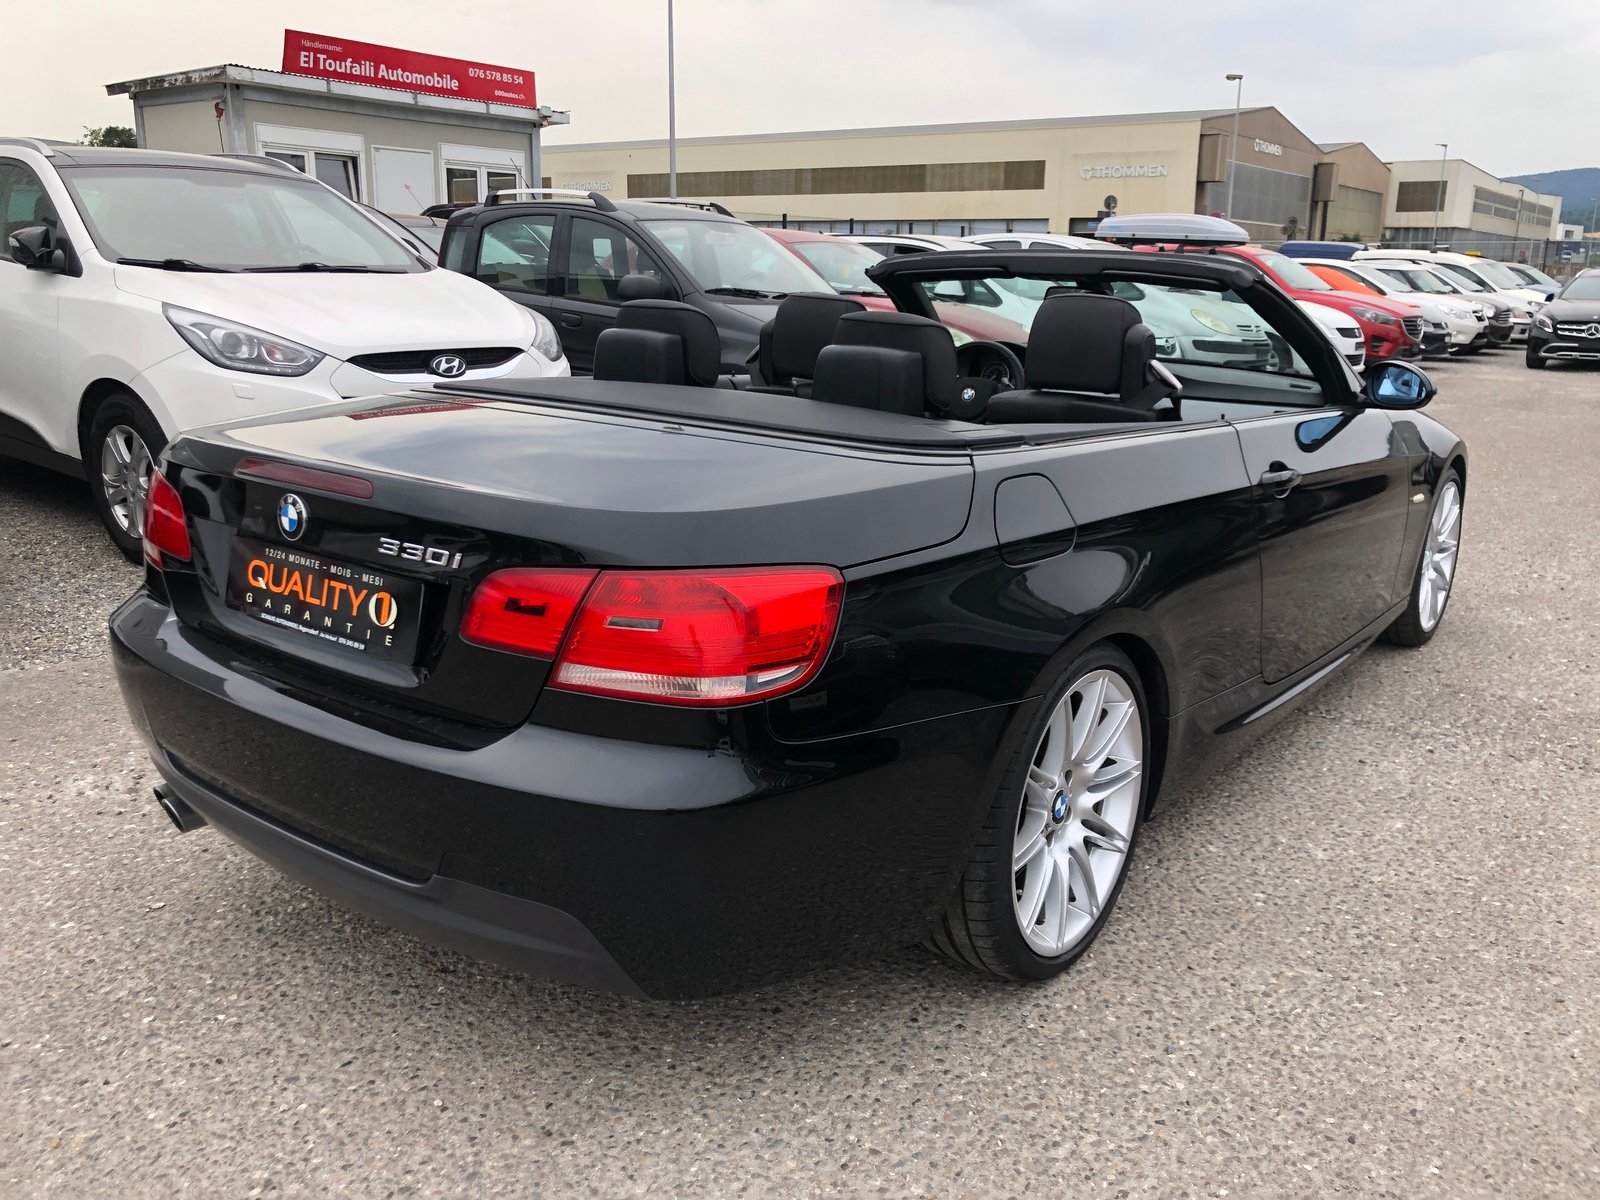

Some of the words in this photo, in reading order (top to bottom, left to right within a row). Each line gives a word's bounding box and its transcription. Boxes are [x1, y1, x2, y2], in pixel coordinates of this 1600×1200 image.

[301, 39, 343, 53] Händlername:
[299, 51, 314, 68] El
[317, 53, 375, 78] Toufaili
[378, 63, 459, 91] Automobile
[468, 67, 485, 79] 076
[486, 70, 502, 81] 578
[502, 73, 513, 83] 85
[513, 75, 524, 85] 54
[1094, 164, 1168, 178] THOMMEN
[265, 548, 286, 560] 12/24
[288, 554, 320, 570] MONATE
[330, 565, 351, 578] MOIS
[362, 573, 384, 587] MESI
[377, 537, 463, 569] 330i
[247, 559, 368, 617] QUALITY
[245, 592, 393, 647] GARANTIE
